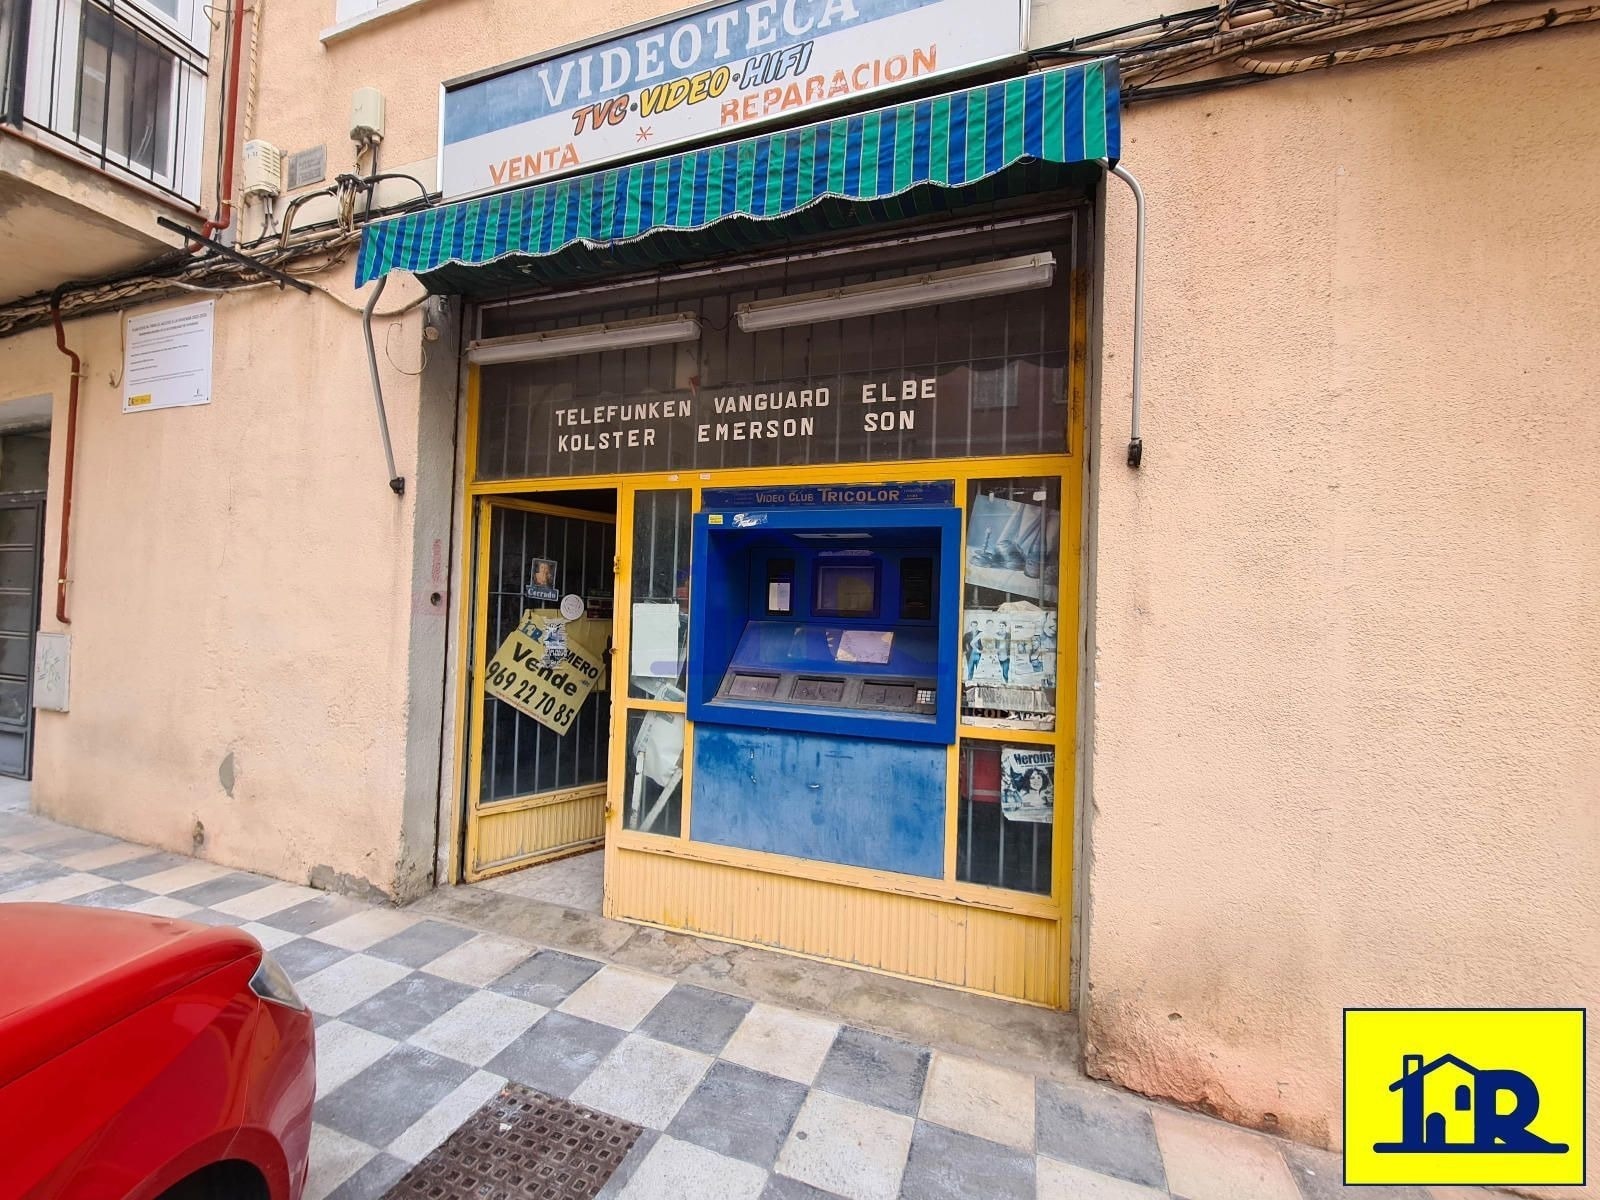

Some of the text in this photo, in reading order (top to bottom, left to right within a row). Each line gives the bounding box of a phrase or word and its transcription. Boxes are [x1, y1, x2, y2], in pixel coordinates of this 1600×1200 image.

[538, 0, 859, 108] VIDEOTECA
[720, 44, 938, 126] REPARACION
[489, 142, 580, 187] VENTA
[556, 378, 937, 427] TELEFUNKEN VANGUARD ELBE
[558, 410, 915, 453] KOLSTER EMERSON SON
[817, 488, 900, 503] TRICOLOR
[485, 661, 517, 691] 969
[513, 679, 538, 704] 22
[534, 691, 556, 716] 70
[553, 703, 575, 727] 85
[512, 641, 577, 696] Vende
